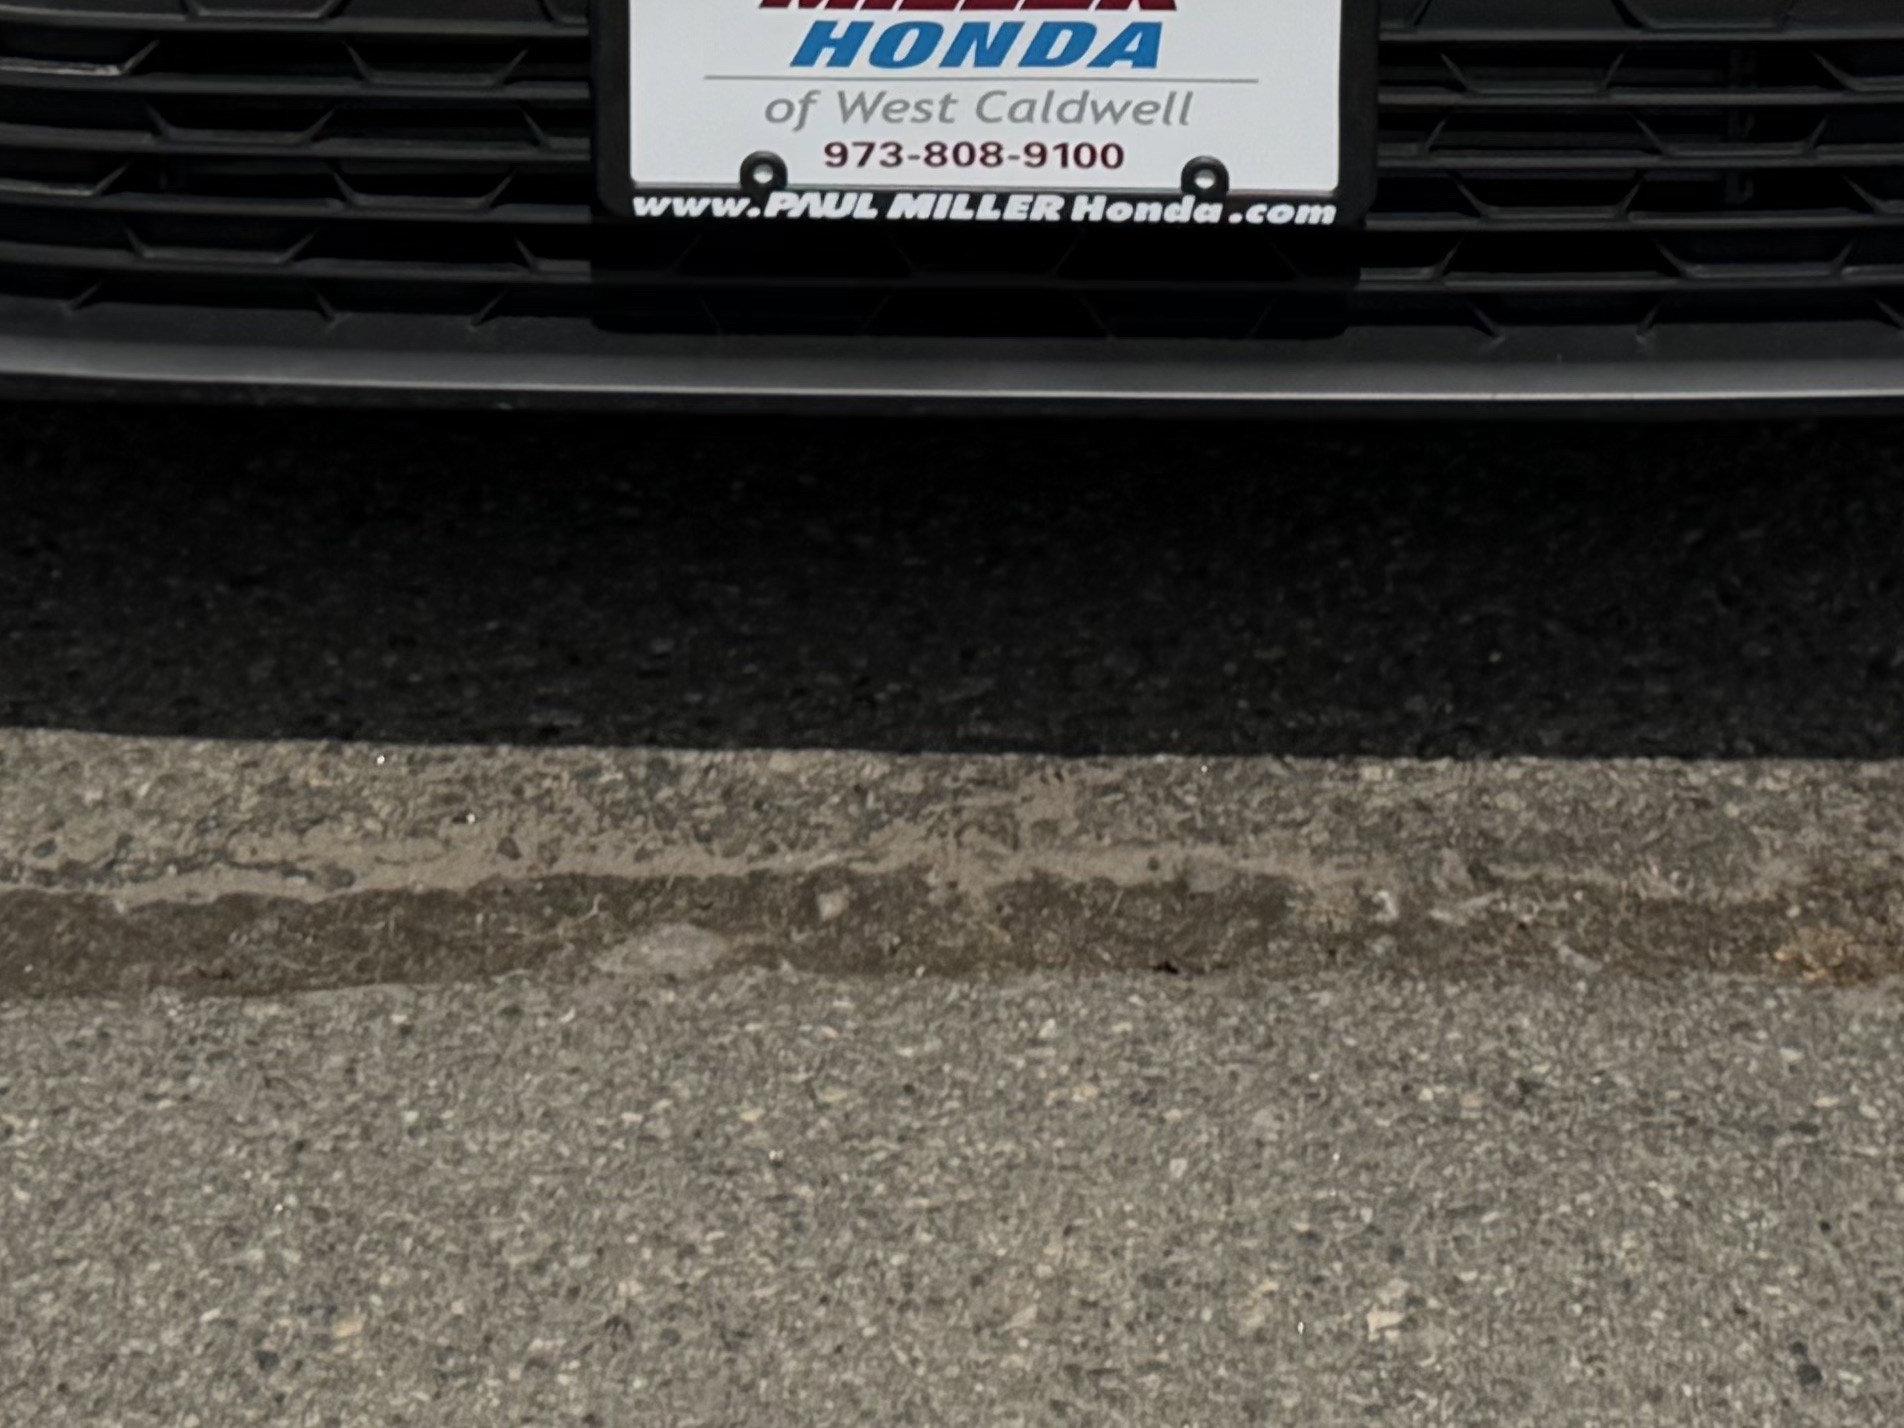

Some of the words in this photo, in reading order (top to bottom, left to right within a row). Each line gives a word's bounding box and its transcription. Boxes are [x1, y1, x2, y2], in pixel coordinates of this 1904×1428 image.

[789, 19, 1164, 69] HONDA
[764, 88, 822, 133] of
[836, 89, 960, 125] West
[975, 88, 1195, 127] Caldwell
[823, 140, 1126, 171] 973-808-9100
